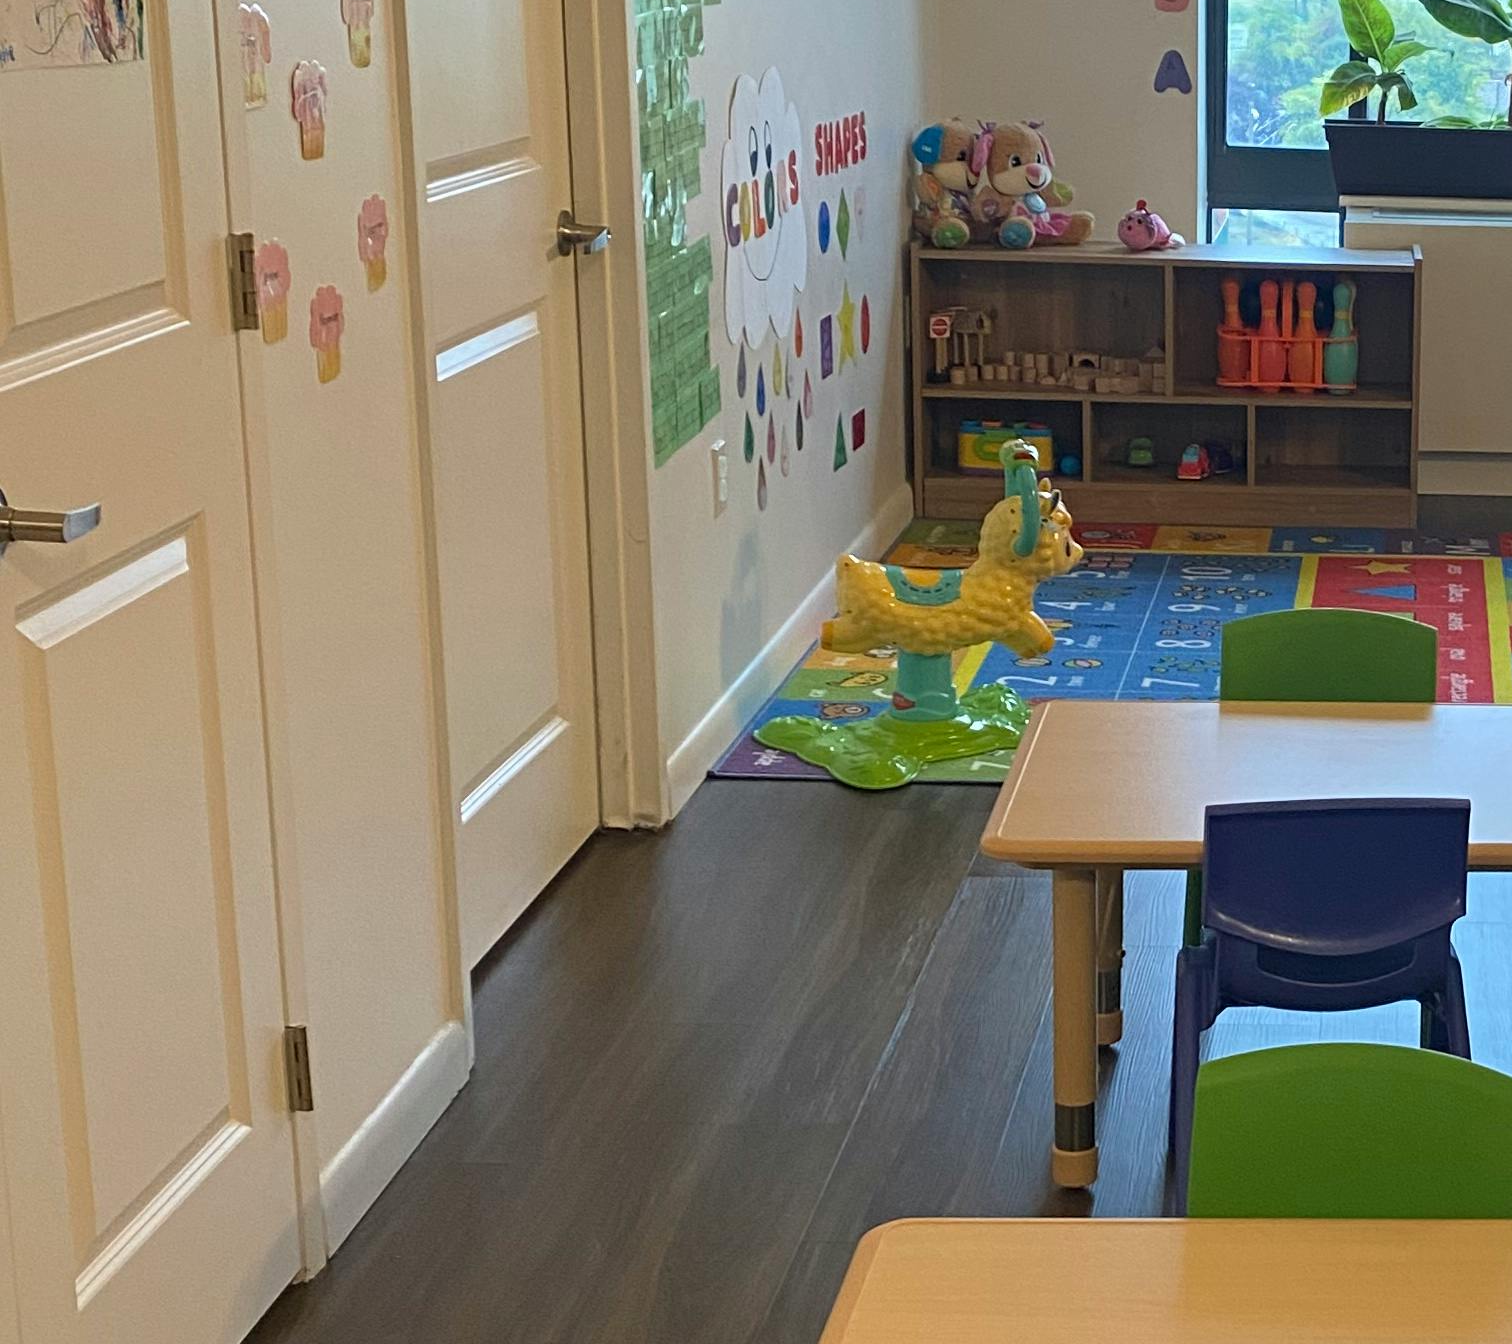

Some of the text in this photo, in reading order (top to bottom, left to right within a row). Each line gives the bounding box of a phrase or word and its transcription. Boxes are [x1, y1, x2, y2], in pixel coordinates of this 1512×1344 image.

[1153, 49, 1193, 95] A
[814, 110, 867, 176] SHAPES
[726, 149, 799, 248] COLORS
[1181, 565, 1233, 581] 10
[1039, 601, 1093, 611] 4
[1168, 603, 1221, 613] 9
[1155, 639, 1212, 649] 8
[997, 675, 1058, 687] 2
[1141, 677, 1200, 688] 7
